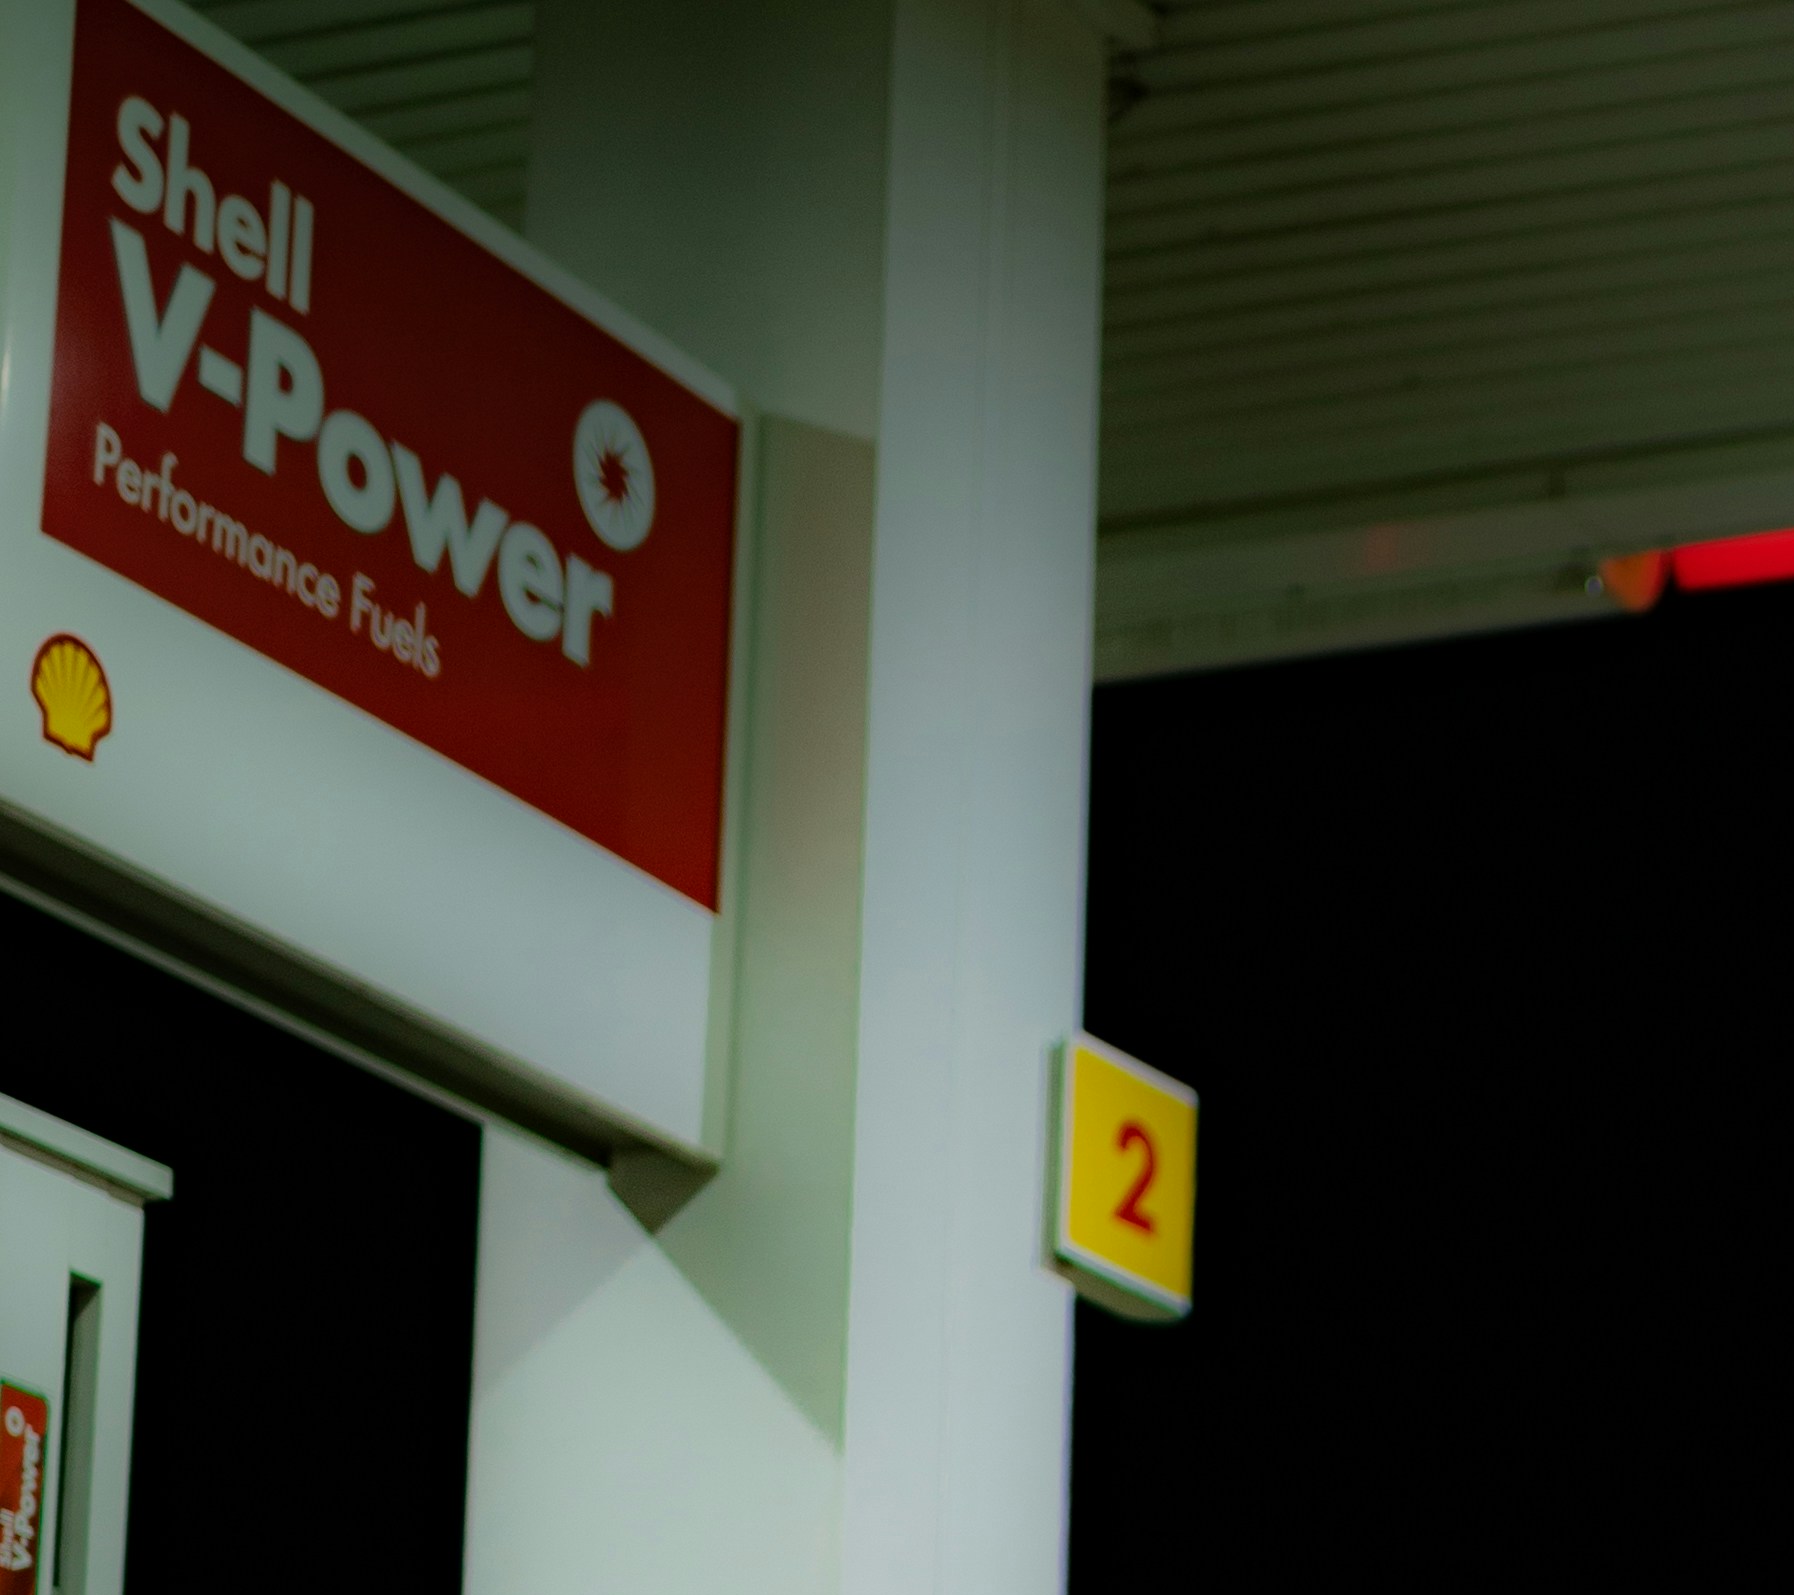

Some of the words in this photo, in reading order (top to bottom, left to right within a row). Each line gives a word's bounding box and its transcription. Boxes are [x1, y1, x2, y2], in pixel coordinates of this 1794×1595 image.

[111, 95, 314, 314] Shell
[93, 423, 340, 619] Performance
[350, 571, 440, 678] Fuels
[110, 216, 613, 668] V-Power
[1114, 1121, 1157, 1237] 2
[12, 1423, 40, 1571] V-Power
